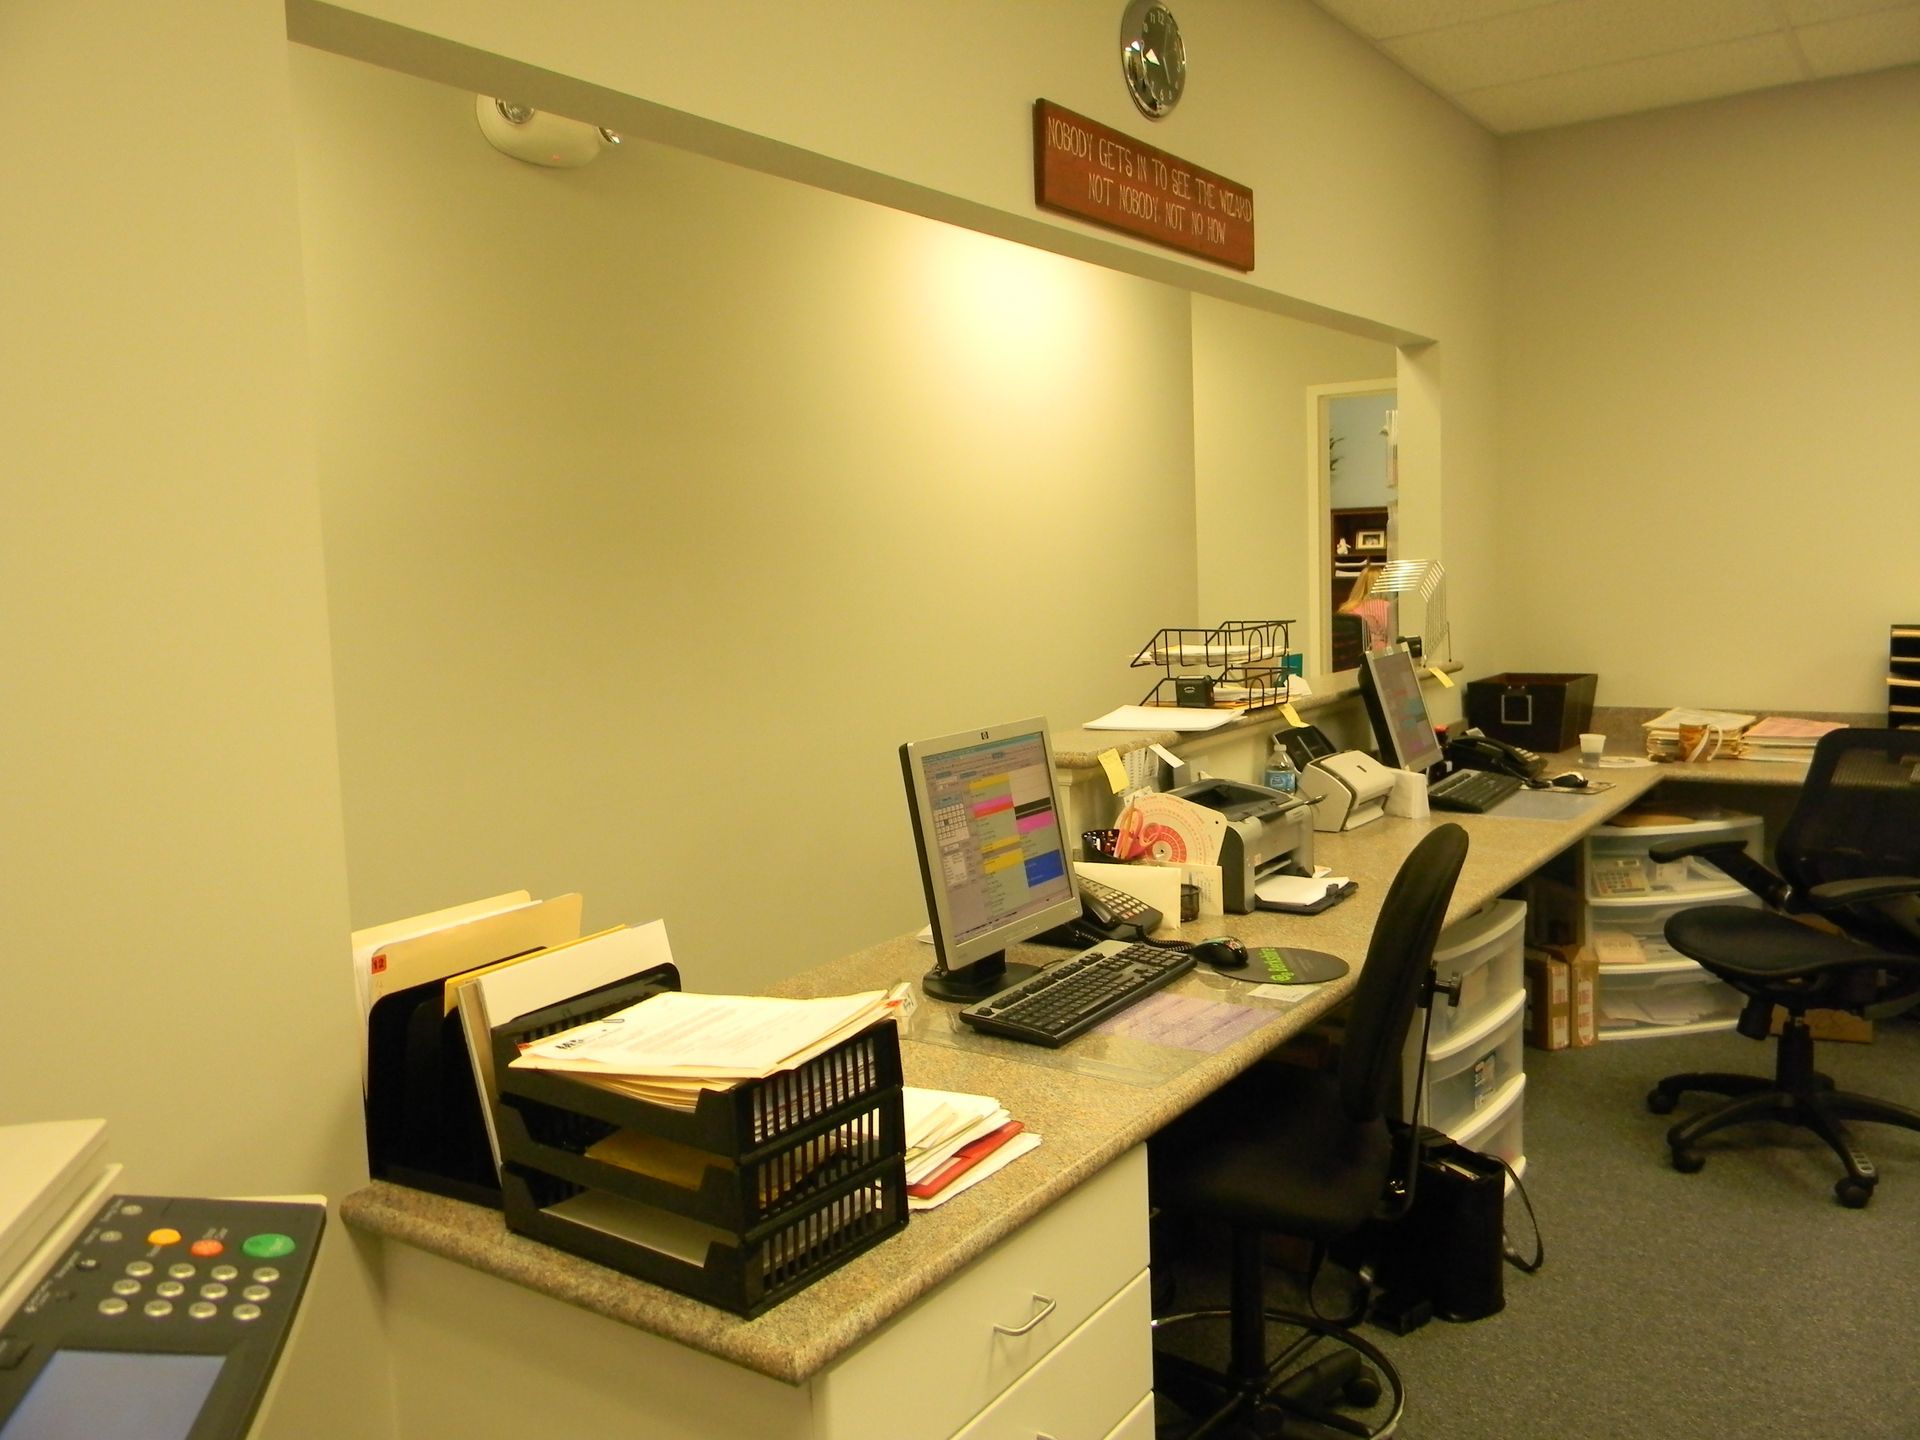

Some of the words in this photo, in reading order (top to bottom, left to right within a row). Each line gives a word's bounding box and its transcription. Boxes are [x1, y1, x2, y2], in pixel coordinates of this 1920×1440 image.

[1048, 116, 1093, 162] NOBODY
[1099, 138, 1133, 177] GETS
[1137, 153, 1148, 184] IN
[1152, 158, 1168, 191] TO
[1172, 168, 1191, 200] SEE
[1195, 178, 1216, 210] THE
[1219, 189, 1252, 223] WIZARD
[1088, 172, 1114, 207] NOT
[1165, 201, 1186, 232] NOT
[1192, 210, 1204, 236] NO
[1207, 216, 1226, 246] HOW
